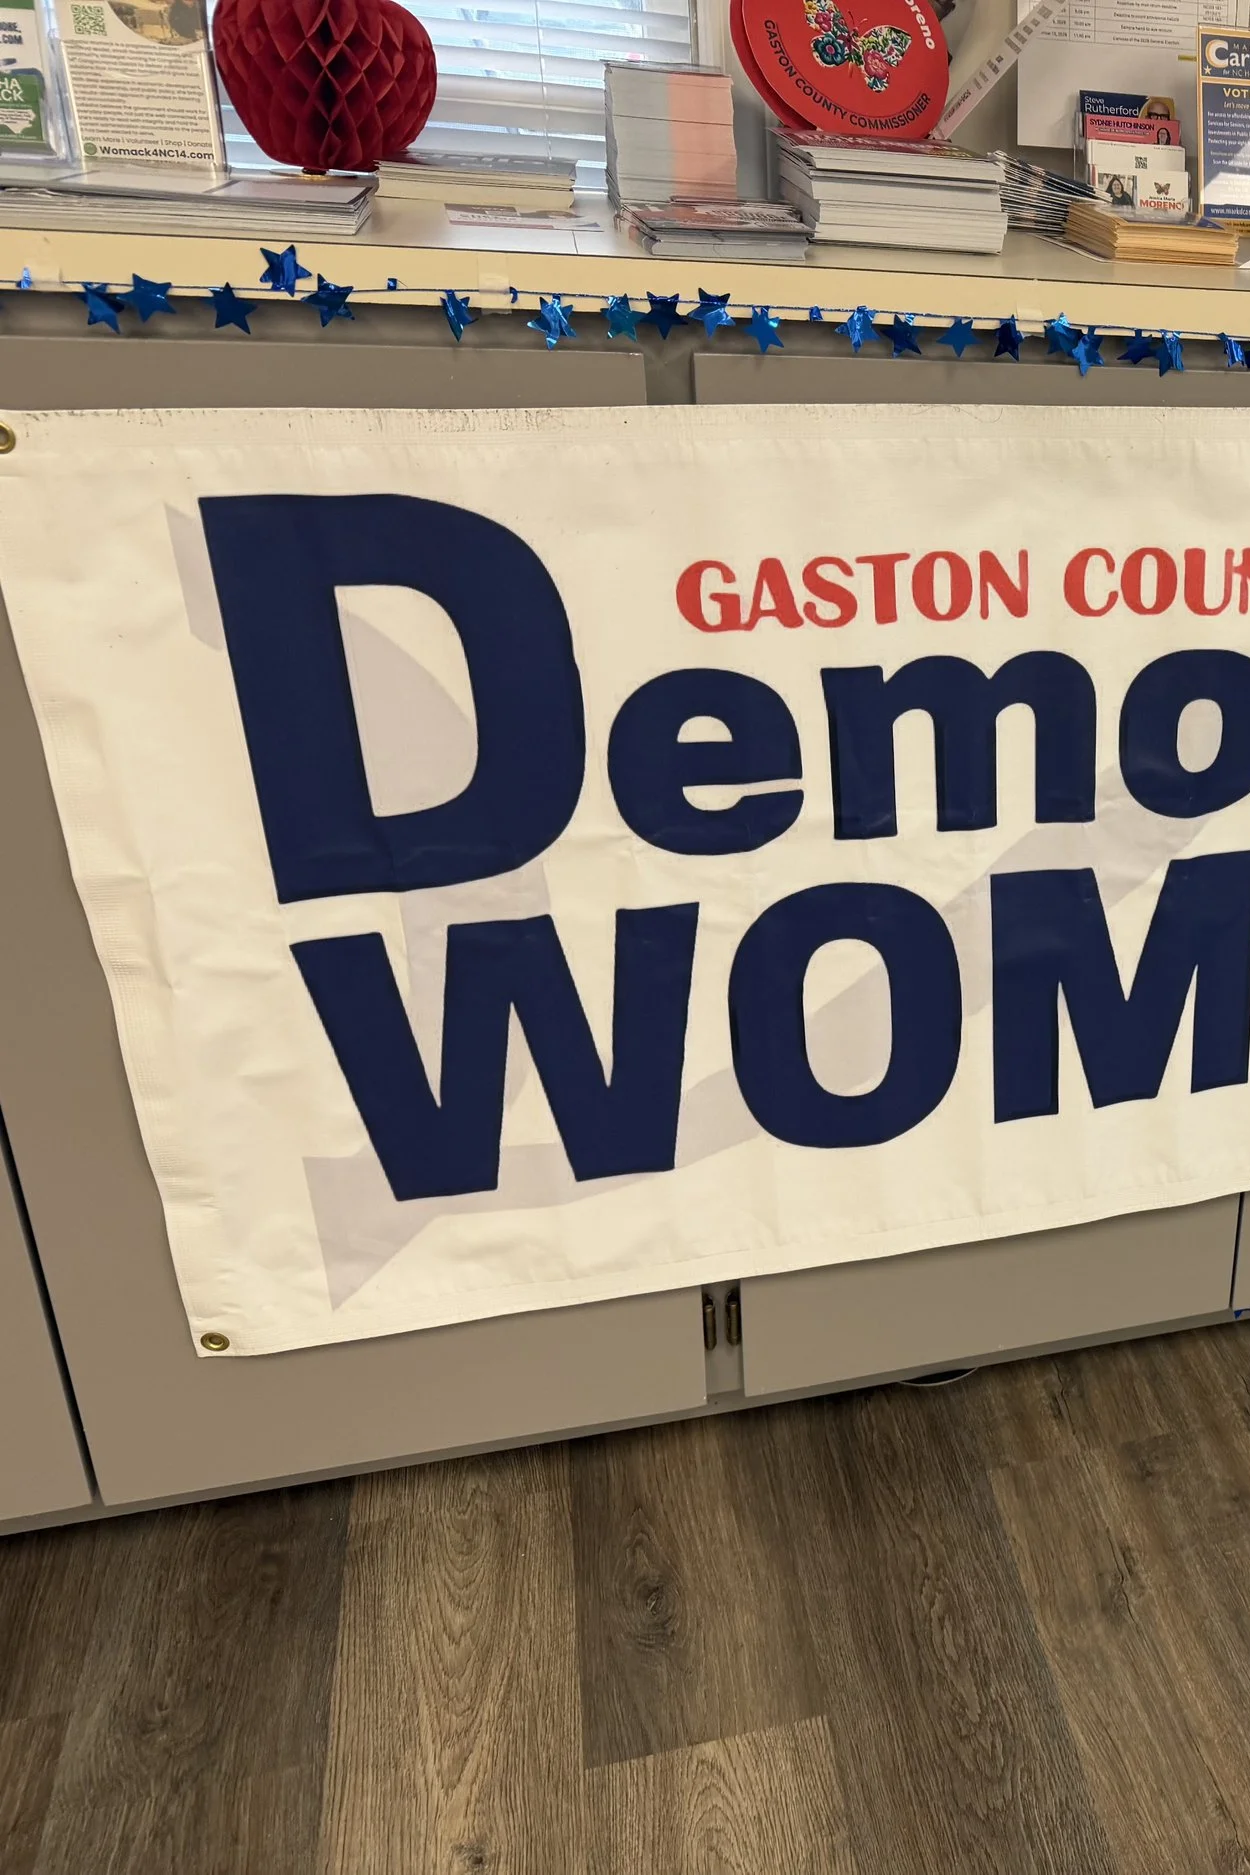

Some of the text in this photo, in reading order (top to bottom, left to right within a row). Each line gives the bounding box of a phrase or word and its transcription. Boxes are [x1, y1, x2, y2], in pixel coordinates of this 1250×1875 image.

[764, 19, 797, 77] GASTON
[795, 77, 848, 120] COUNTY
[849, 92, 932, 132] COMMISSIONER
[1085, 103, 1139, 116] Rutherford
[1090, 119, 1155, 131] SYDNIE HUTCHINSON
[100, 146, 214, 160] Womack4NC14.com
[676, 549, 1029, 632] GASTON
